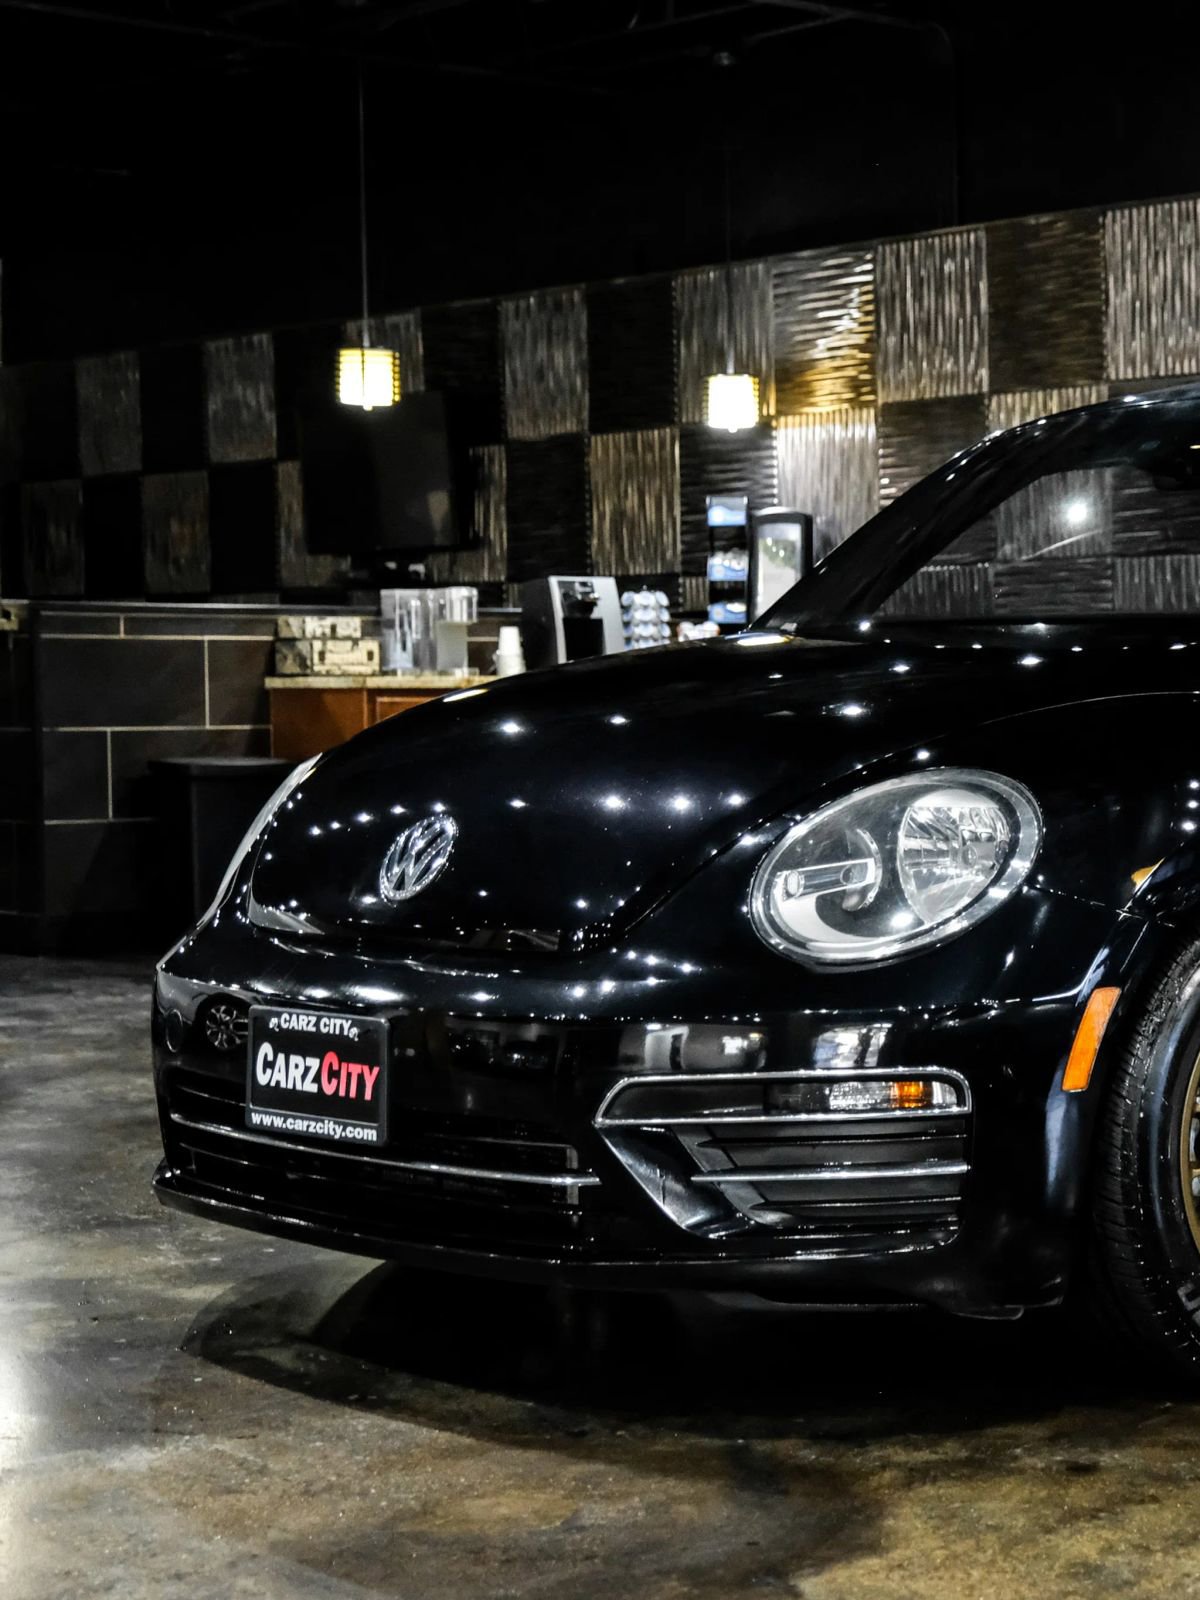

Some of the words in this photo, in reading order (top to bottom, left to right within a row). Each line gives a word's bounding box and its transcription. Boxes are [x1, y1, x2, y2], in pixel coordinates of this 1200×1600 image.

[280, 1012, 317, 1034] CARZ
[319, 1017, 352, 1036] CITY
[250, 1111, 378, 1142] www.carzcity.com
